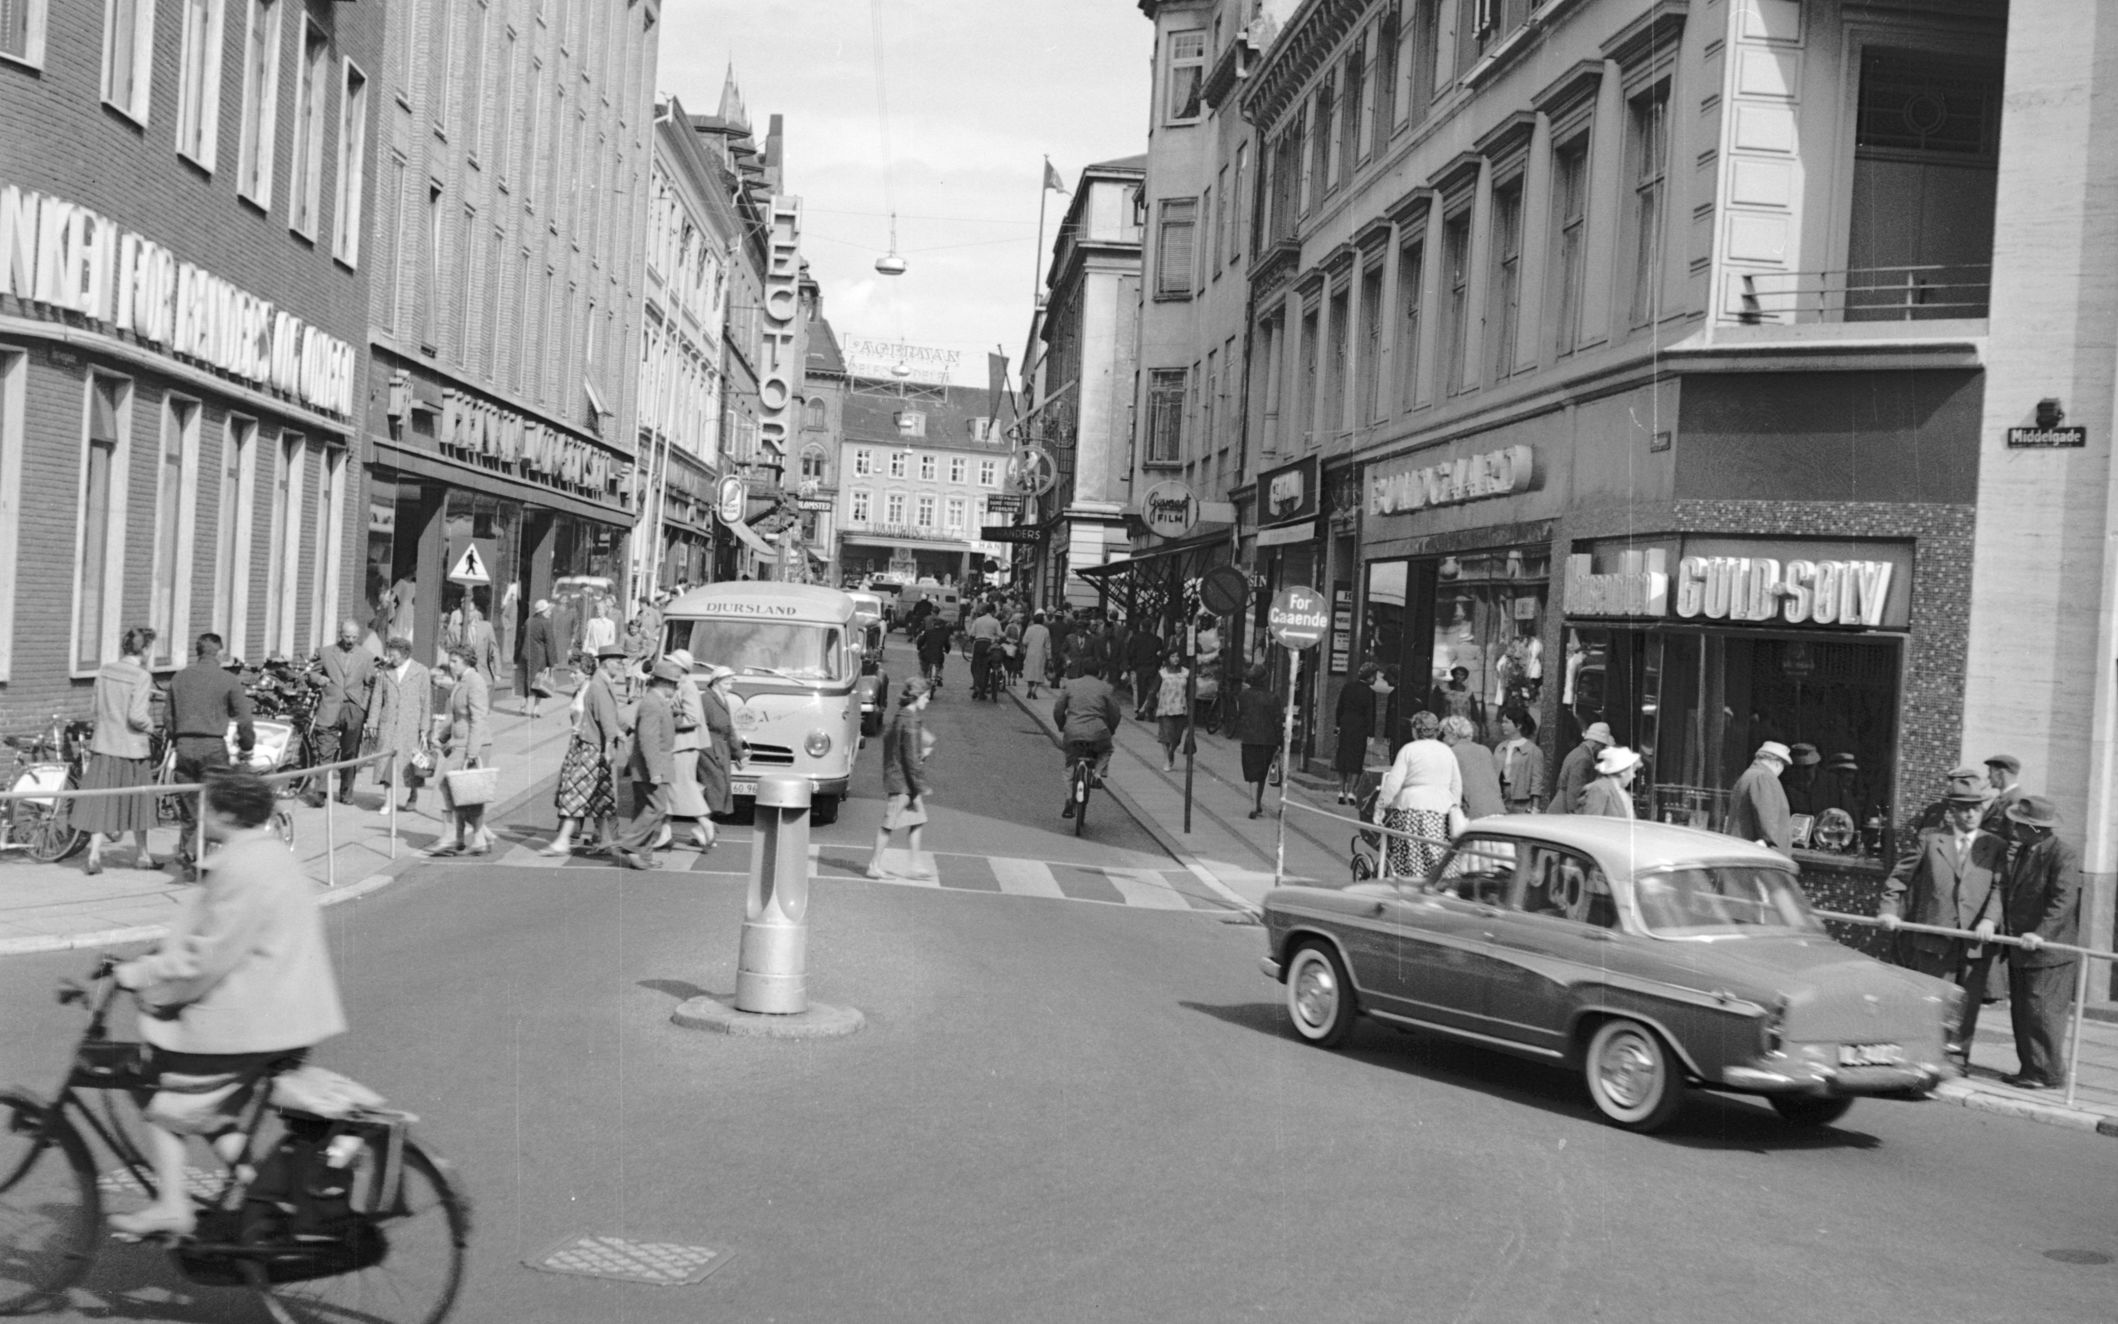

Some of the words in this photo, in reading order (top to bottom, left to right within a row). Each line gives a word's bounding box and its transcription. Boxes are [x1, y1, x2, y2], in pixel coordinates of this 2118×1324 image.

[116, 231, 175, 347] FOR
[759, 195, 803, 456] HECTOR
[2011, 429, 2082, 446] Middelgade
[1157, 514, 1183, 523] FILM
[706, 602, 797, 616] DJURSLAND
[1289, 593, 1313, 611] For
[1270, 607, 1328, 628] Gaaende
